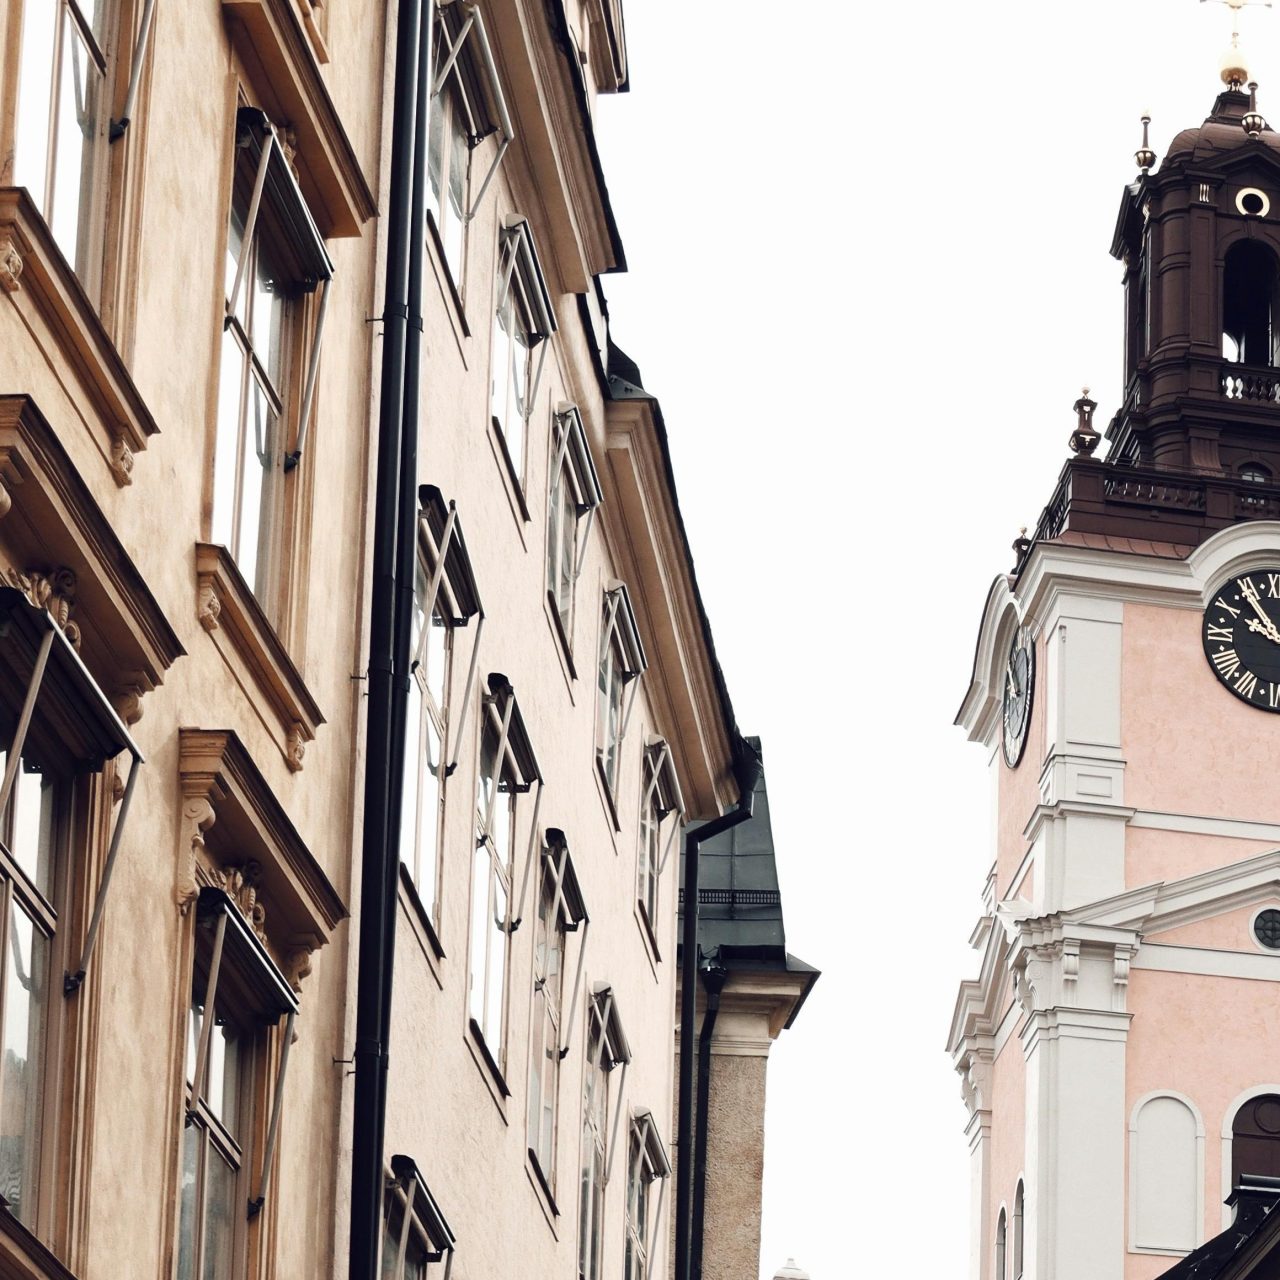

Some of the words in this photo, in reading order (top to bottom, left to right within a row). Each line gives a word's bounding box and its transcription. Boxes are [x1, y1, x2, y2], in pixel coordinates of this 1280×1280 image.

[1215, 596, 1241, 619] X
[1207, 623, 1233, 642] IX
[1212, 649, 1241, 681] VIII
[1233, 671, 1258, 699] VII
